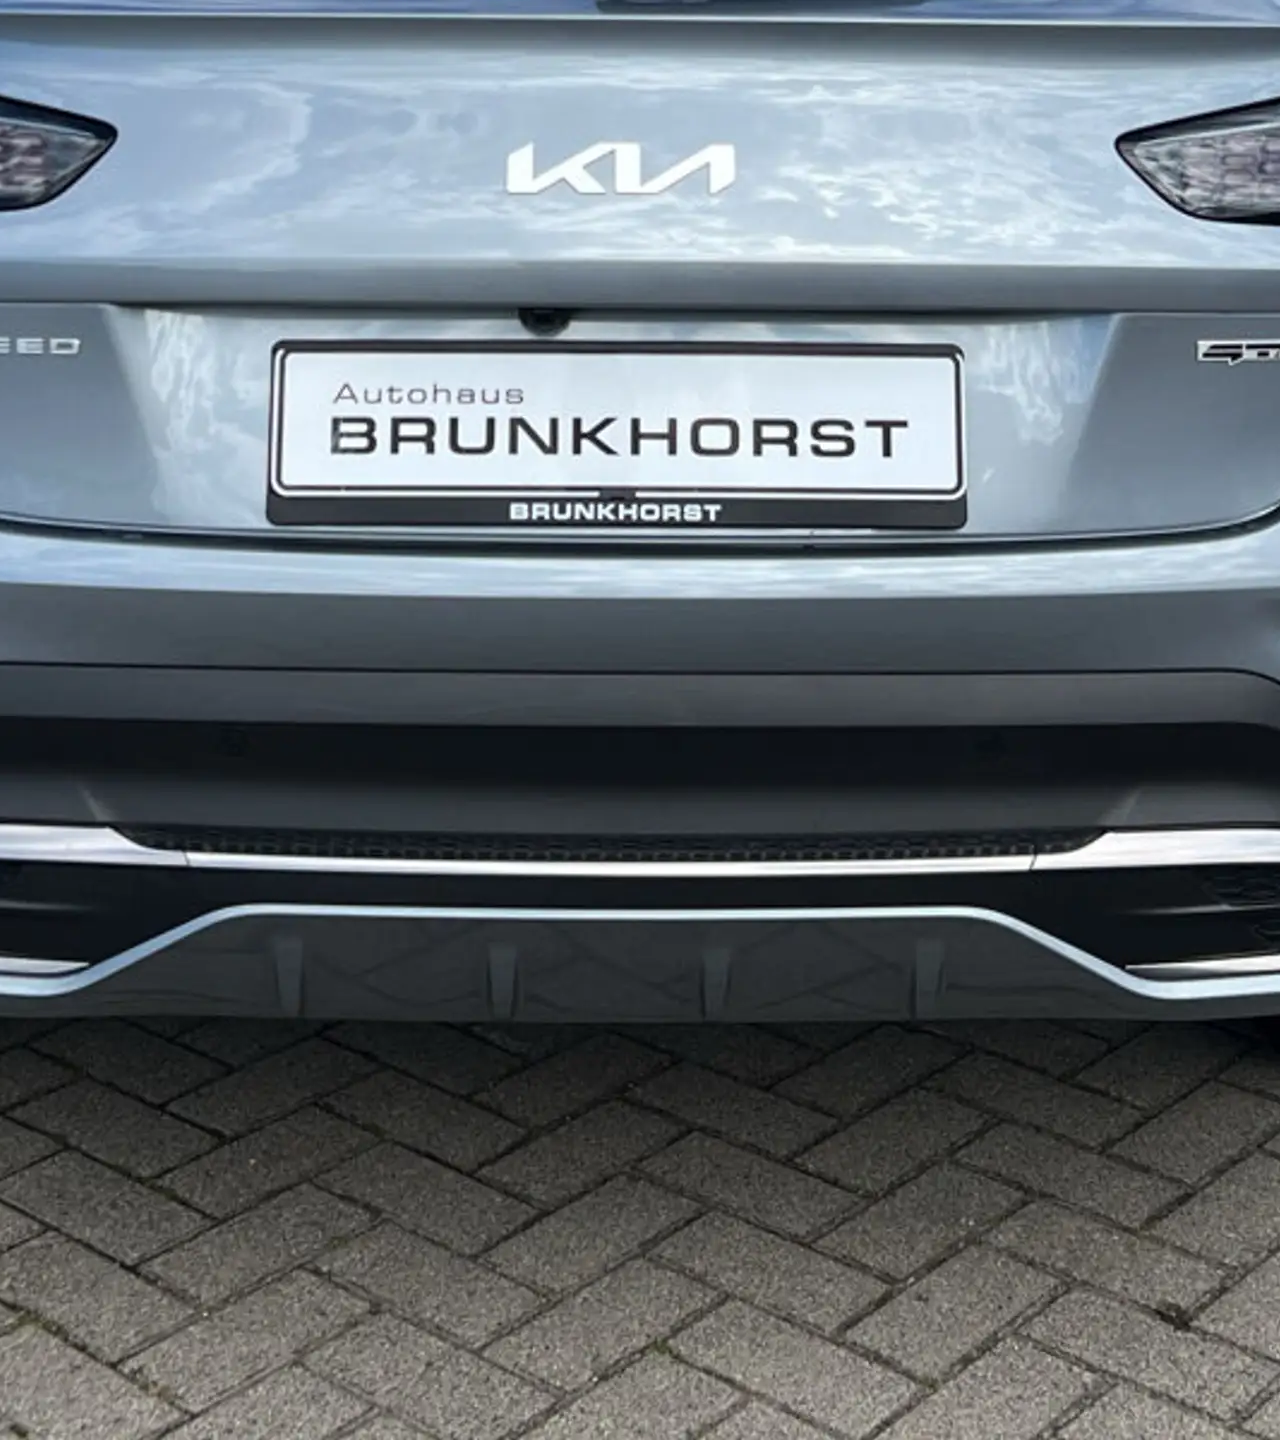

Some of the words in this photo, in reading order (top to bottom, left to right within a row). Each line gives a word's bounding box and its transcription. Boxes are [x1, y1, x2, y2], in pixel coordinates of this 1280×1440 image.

[505, 140, 737, 195] KIA
[332, 382, 525, 406] Autohaus
[330, 416, 910, 458] BRUNKHORST
[508, 501, 722, 524] BRUNKHORST
